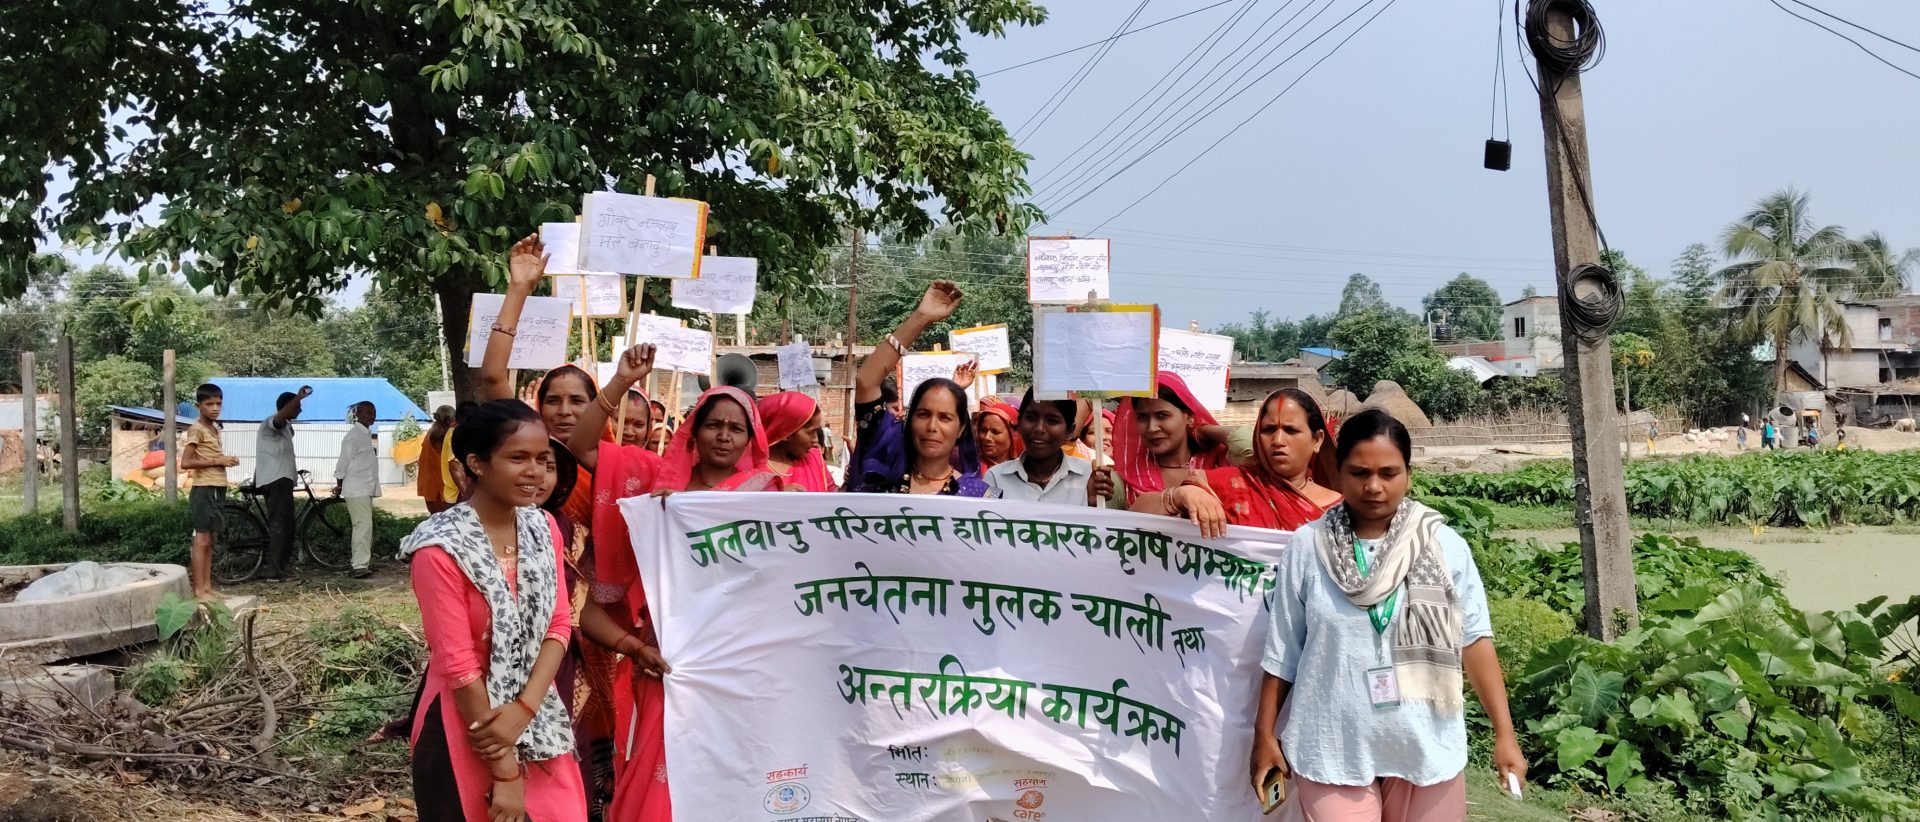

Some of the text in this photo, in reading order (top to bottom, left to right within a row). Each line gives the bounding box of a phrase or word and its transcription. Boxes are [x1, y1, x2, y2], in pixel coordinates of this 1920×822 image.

[685, 519, 810, 568] जलवायु
[807, 506, 945, 547] परिवर्तन
[951, 510, 1102, 558] हानिकारक
[793, 561, 955, 625] जनचेतना
[959, 580, 1063, 636] मुलक
[1170, 626, 1206, 669] तथा
[836, 654, 1186, 759] अन्तरक्रिया कार्यक्रम
[766, 763, 809, 781] सहकार्य
[1013, 809, 1041, 821] care
